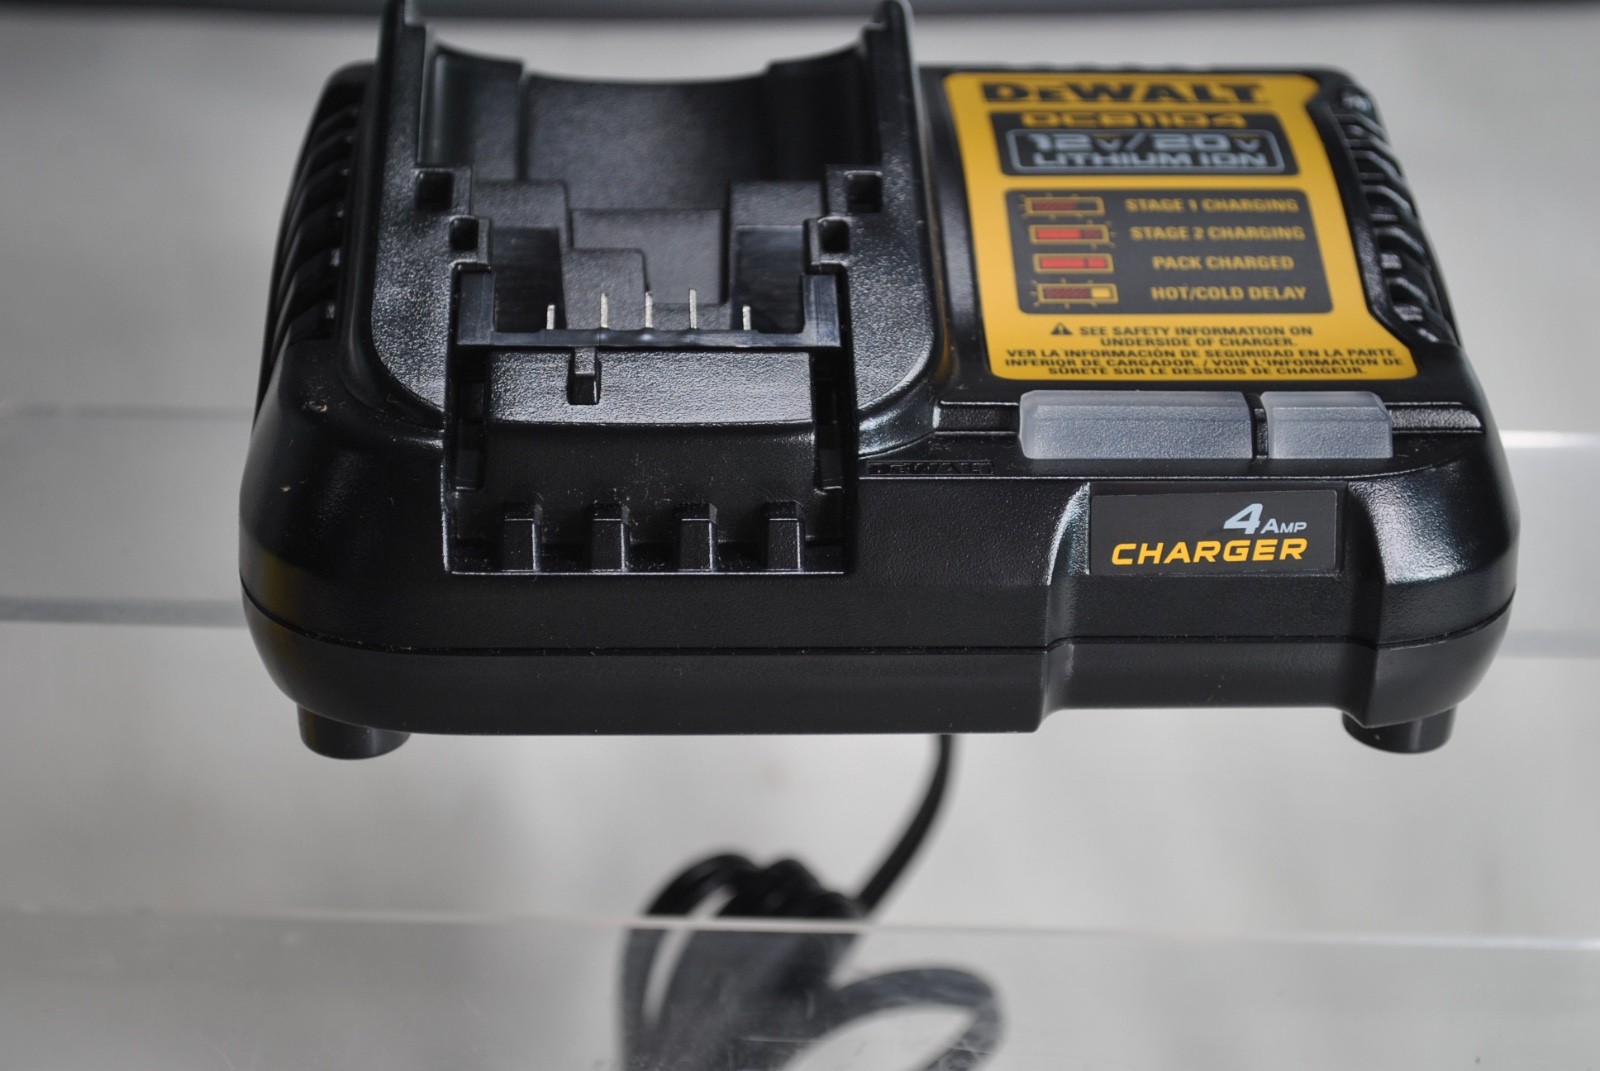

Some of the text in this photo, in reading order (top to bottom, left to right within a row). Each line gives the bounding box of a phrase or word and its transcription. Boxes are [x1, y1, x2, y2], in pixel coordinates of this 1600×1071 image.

[1033, 152, 1268, 167] LITHIUM ION
[1124, 198, 1299, 213] STAGE 1 CHARGING
[1130, 226, 1305, 241] STAGE 2 CHARGING
[1152, 256, 1294, 270] PACK CHARGED
[1151, 286, 1307, 301] HOT/COLD DELAY
[1079, 326, 1313, 336] SEE SAFETY INFORMATION ON
[1100, 338, 1191, 347] UNDERSIDE
[1195, 338, 1213, 347] OF
[1006, 349, 1037, 358] VER
[1041, 349, 1060, 358] LA
[1180, 349, 1201, 358] DE
[1205, 349, 1295, 358] SEGURIDAD
[1299, 349, 1321, 358] EN
[1324, 349, 1346, 357] LA
[1350, 348, 1396, 357] PARTE
[1081, 359, 1101, 367] DE
[1113, 367, 1147, 375] SUR
[1150, 367, 1168, 375] LE
[1171, 367, 1247, 375] DESSOUS
[1251, 367, 1272, 375] DE
[1223, 503, 1262, 535] 4
[1110, 537, 1308, 567] CHARGER
